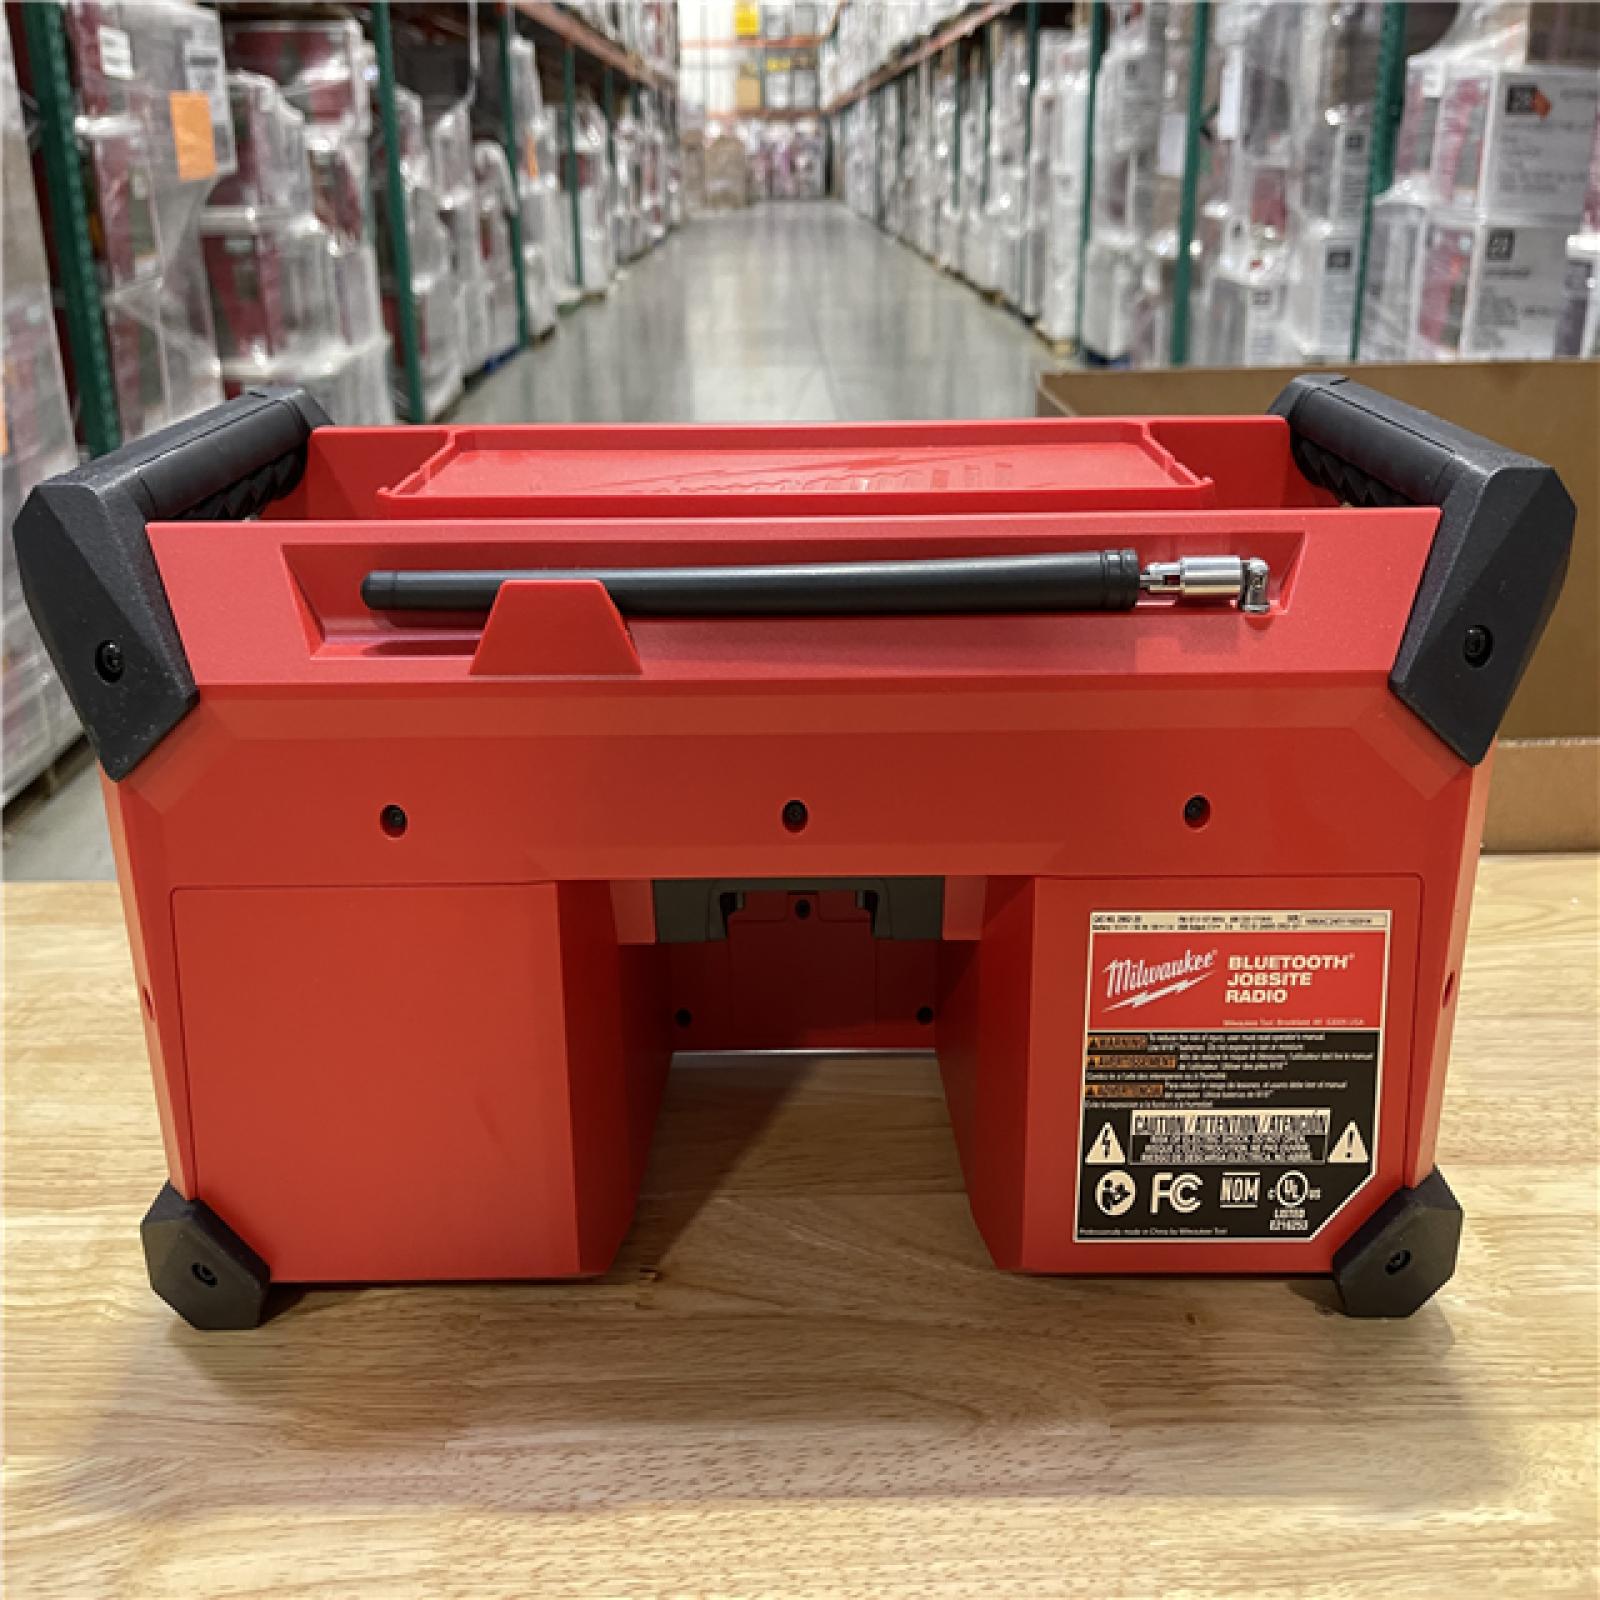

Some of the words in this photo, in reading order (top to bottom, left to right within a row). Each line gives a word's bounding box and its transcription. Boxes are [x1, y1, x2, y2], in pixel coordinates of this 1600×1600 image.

[1102, 948, 1215, 999] Milwaukee
[1226, 971, 1312, 987] JOBSITE
[1224, 988, 1289, 1004] RADIO
[1219, 1176, 1261, 1203] NOM
